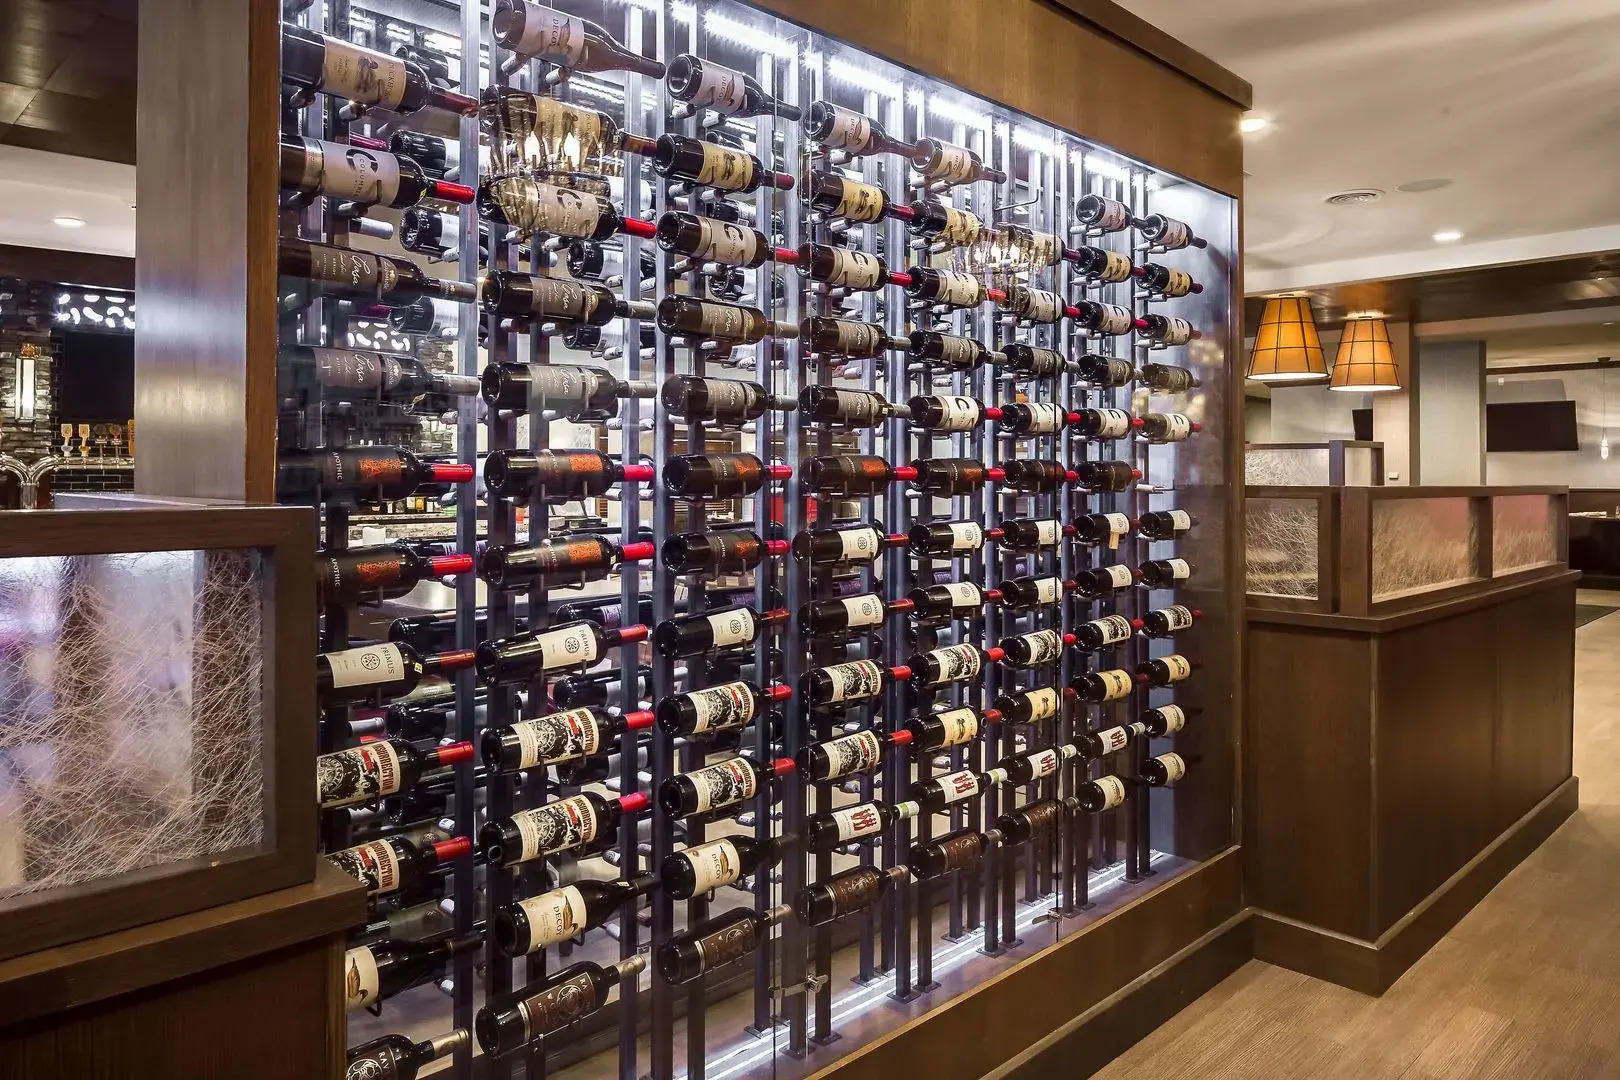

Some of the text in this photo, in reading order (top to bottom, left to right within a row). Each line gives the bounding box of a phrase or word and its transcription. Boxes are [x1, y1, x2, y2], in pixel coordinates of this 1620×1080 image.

[352, 255, 371, 286] Casa
[562, 283, 578, 310] Casa
[353, 354, 374, 383] Casa
[561, 368, 577, 394] Casa
[332, 451, 343, 480] APOTHIC
[330, 557, 341, 588] APOTHIC
[578, 629, 590, 657] PRIMUS
[380, 647, 395, 675] PRIMUS
[711, 853, 722, 880] DECOY
[553, 905, 563, 936] DECOY
